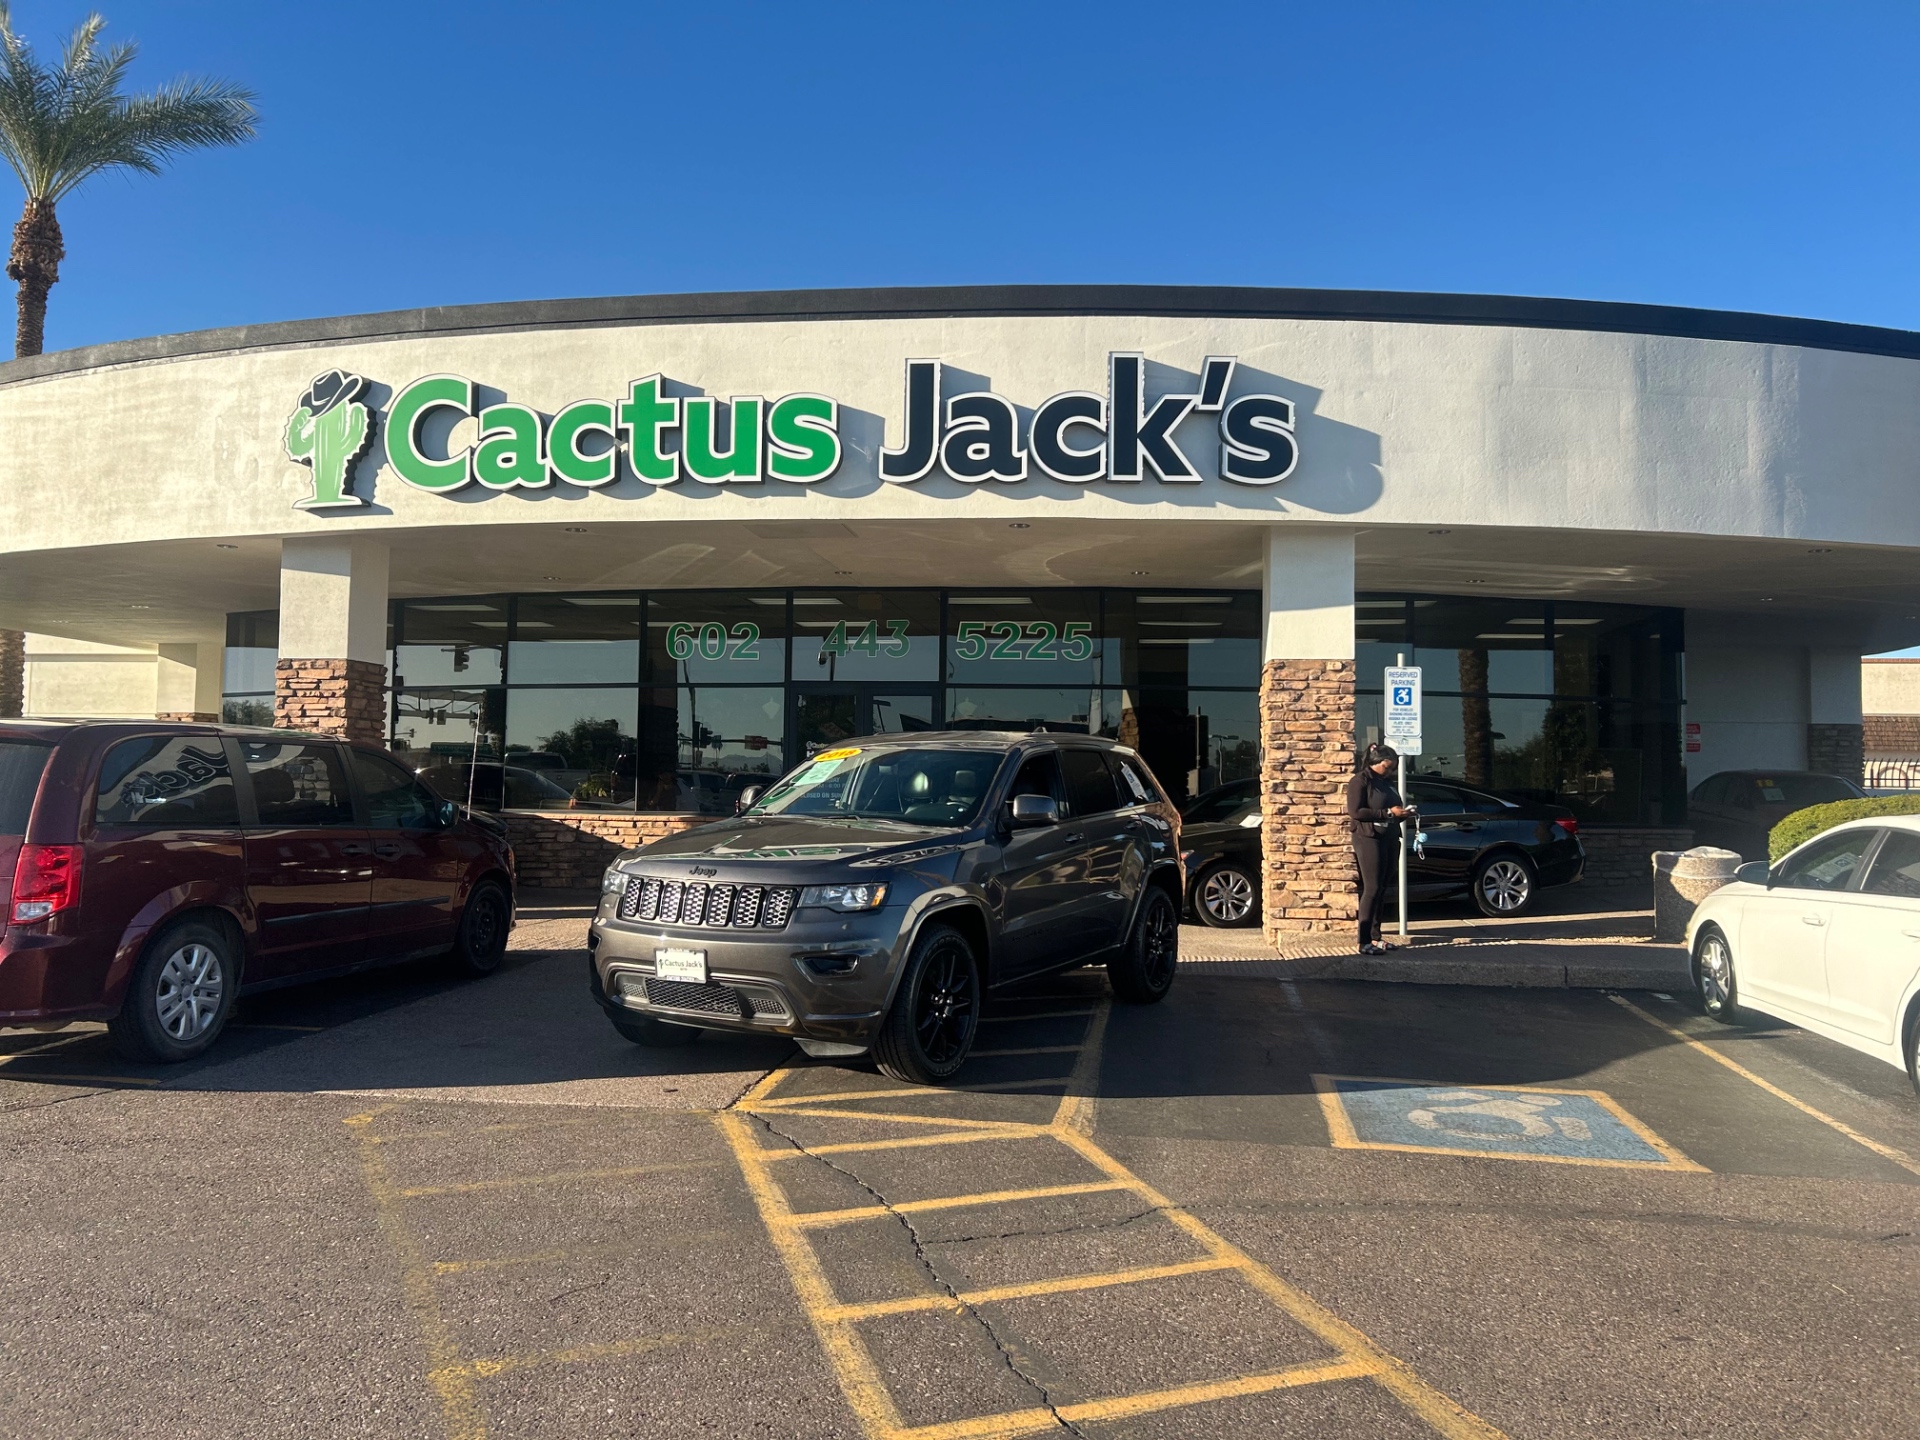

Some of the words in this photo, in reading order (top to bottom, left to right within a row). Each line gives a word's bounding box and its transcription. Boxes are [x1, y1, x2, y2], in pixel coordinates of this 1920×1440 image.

[384, 371, 841, 493] Cactus
[879, 352, 1297, 487] Jack's
[665, 621, 760, 661] 602
[820, 619, 910, 658] 443
[955, 621, 1093, 662] 5225
[689, 865, 718, 877] Jeep
[664, 958, 684, 968] Cactus
[685, 960, 703, 968] Jack's
